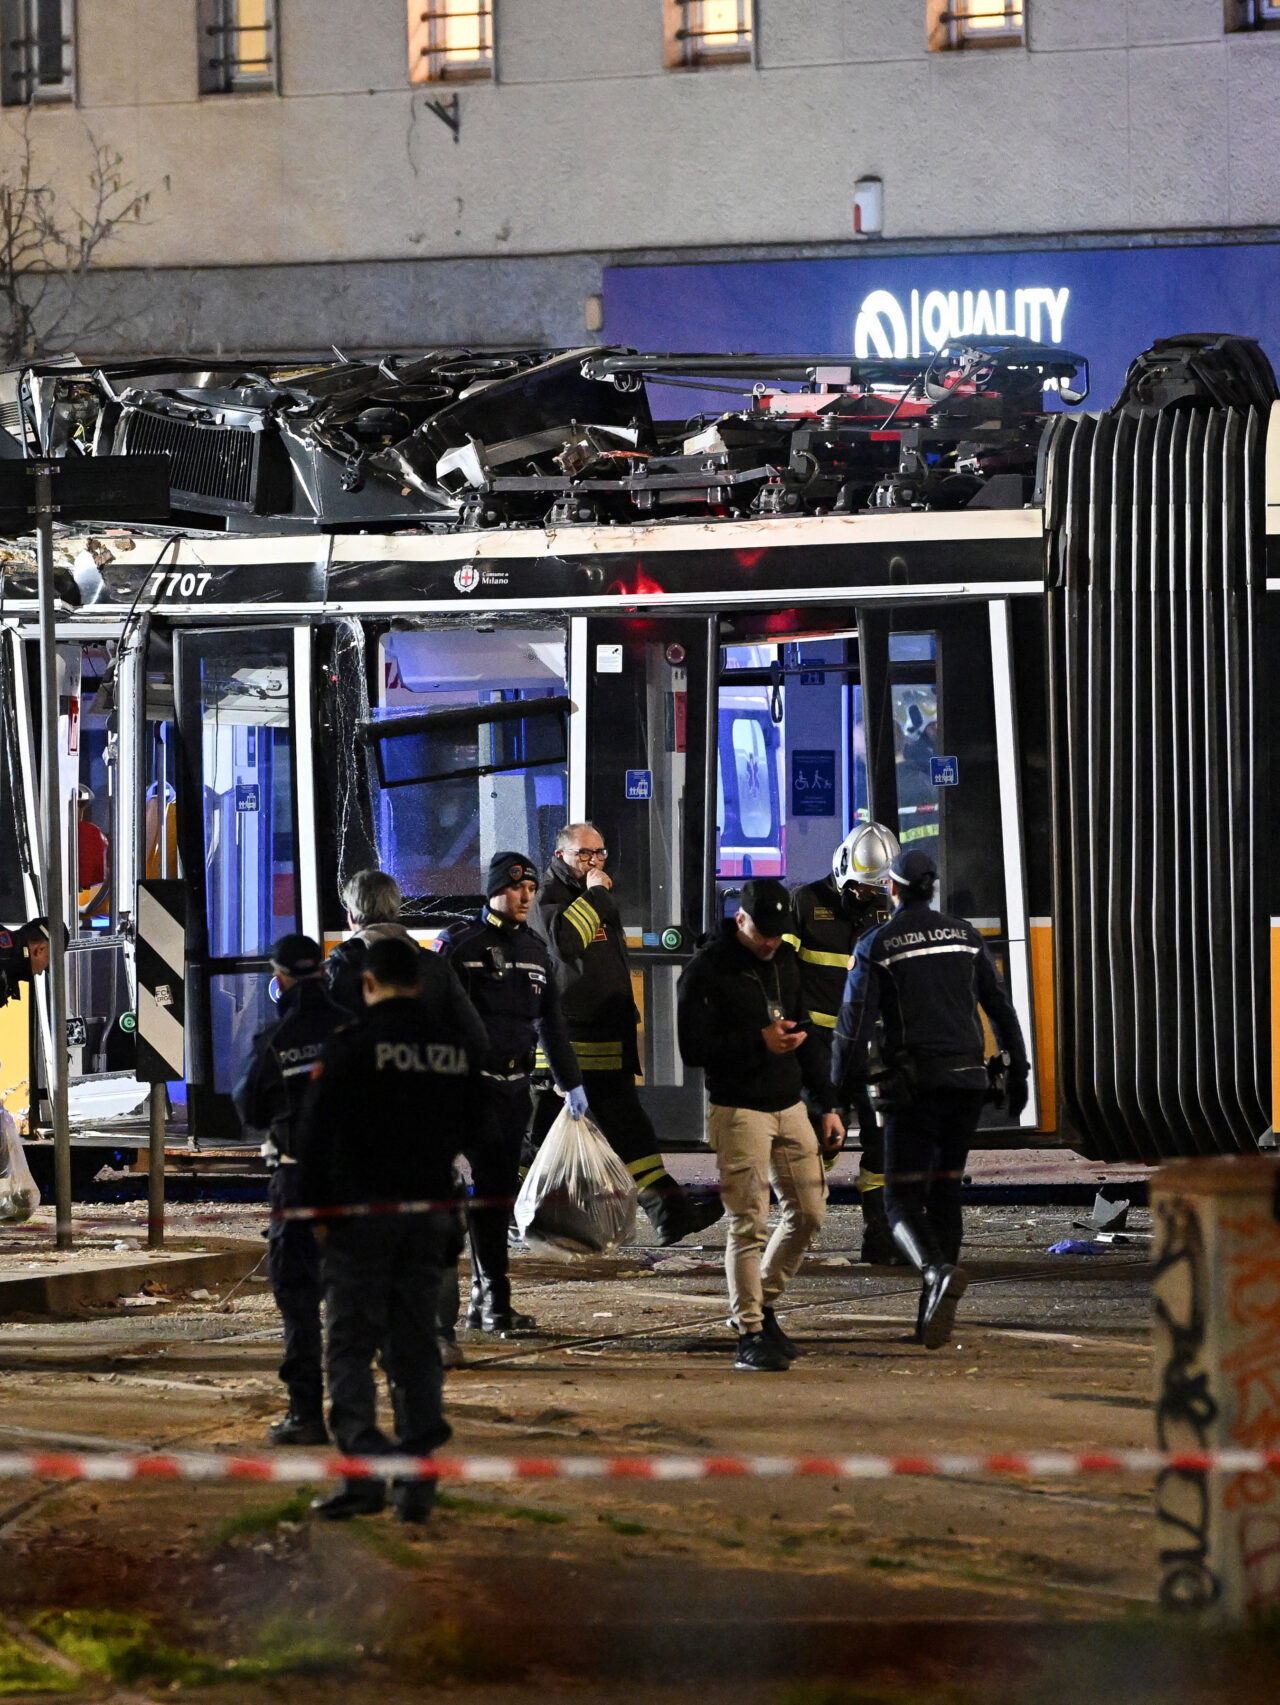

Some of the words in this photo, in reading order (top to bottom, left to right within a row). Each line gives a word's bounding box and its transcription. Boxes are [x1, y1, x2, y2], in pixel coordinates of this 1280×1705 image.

[922, 288, 1070, 350] QUALITY
[150, 572, 212, 597] 7707
[482, 577, 509, 585] Milano
[883, 931, 926, 951] POLIZIA
[927, 927, 968, 941] LOCALE
[375, 1043, 469, 1075] POLIZIA
